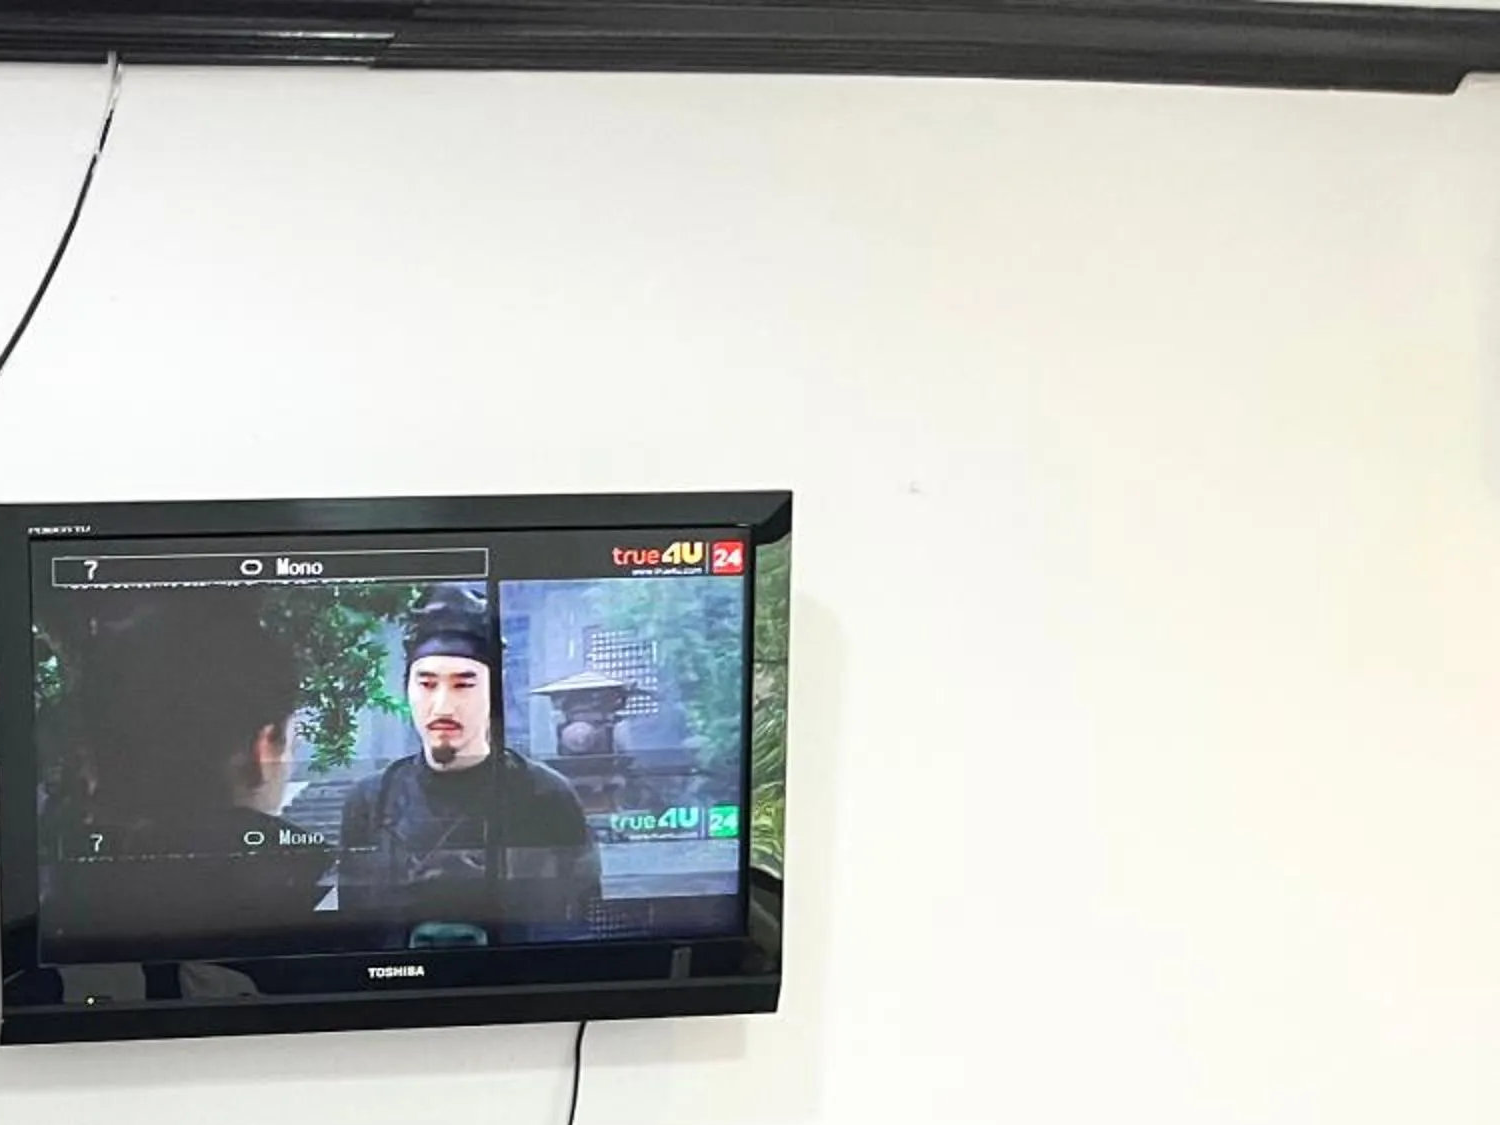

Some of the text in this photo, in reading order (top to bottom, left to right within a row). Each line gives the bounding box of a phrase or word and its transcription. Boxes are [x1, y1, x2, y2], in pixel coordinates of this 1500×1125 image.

[612, 541, 742, 567] true4U 24
[276, 558, 323, 576] Mono
[279, 829, 324, 845] Mono
[367, 965, 425, 979] TOSHIBA
